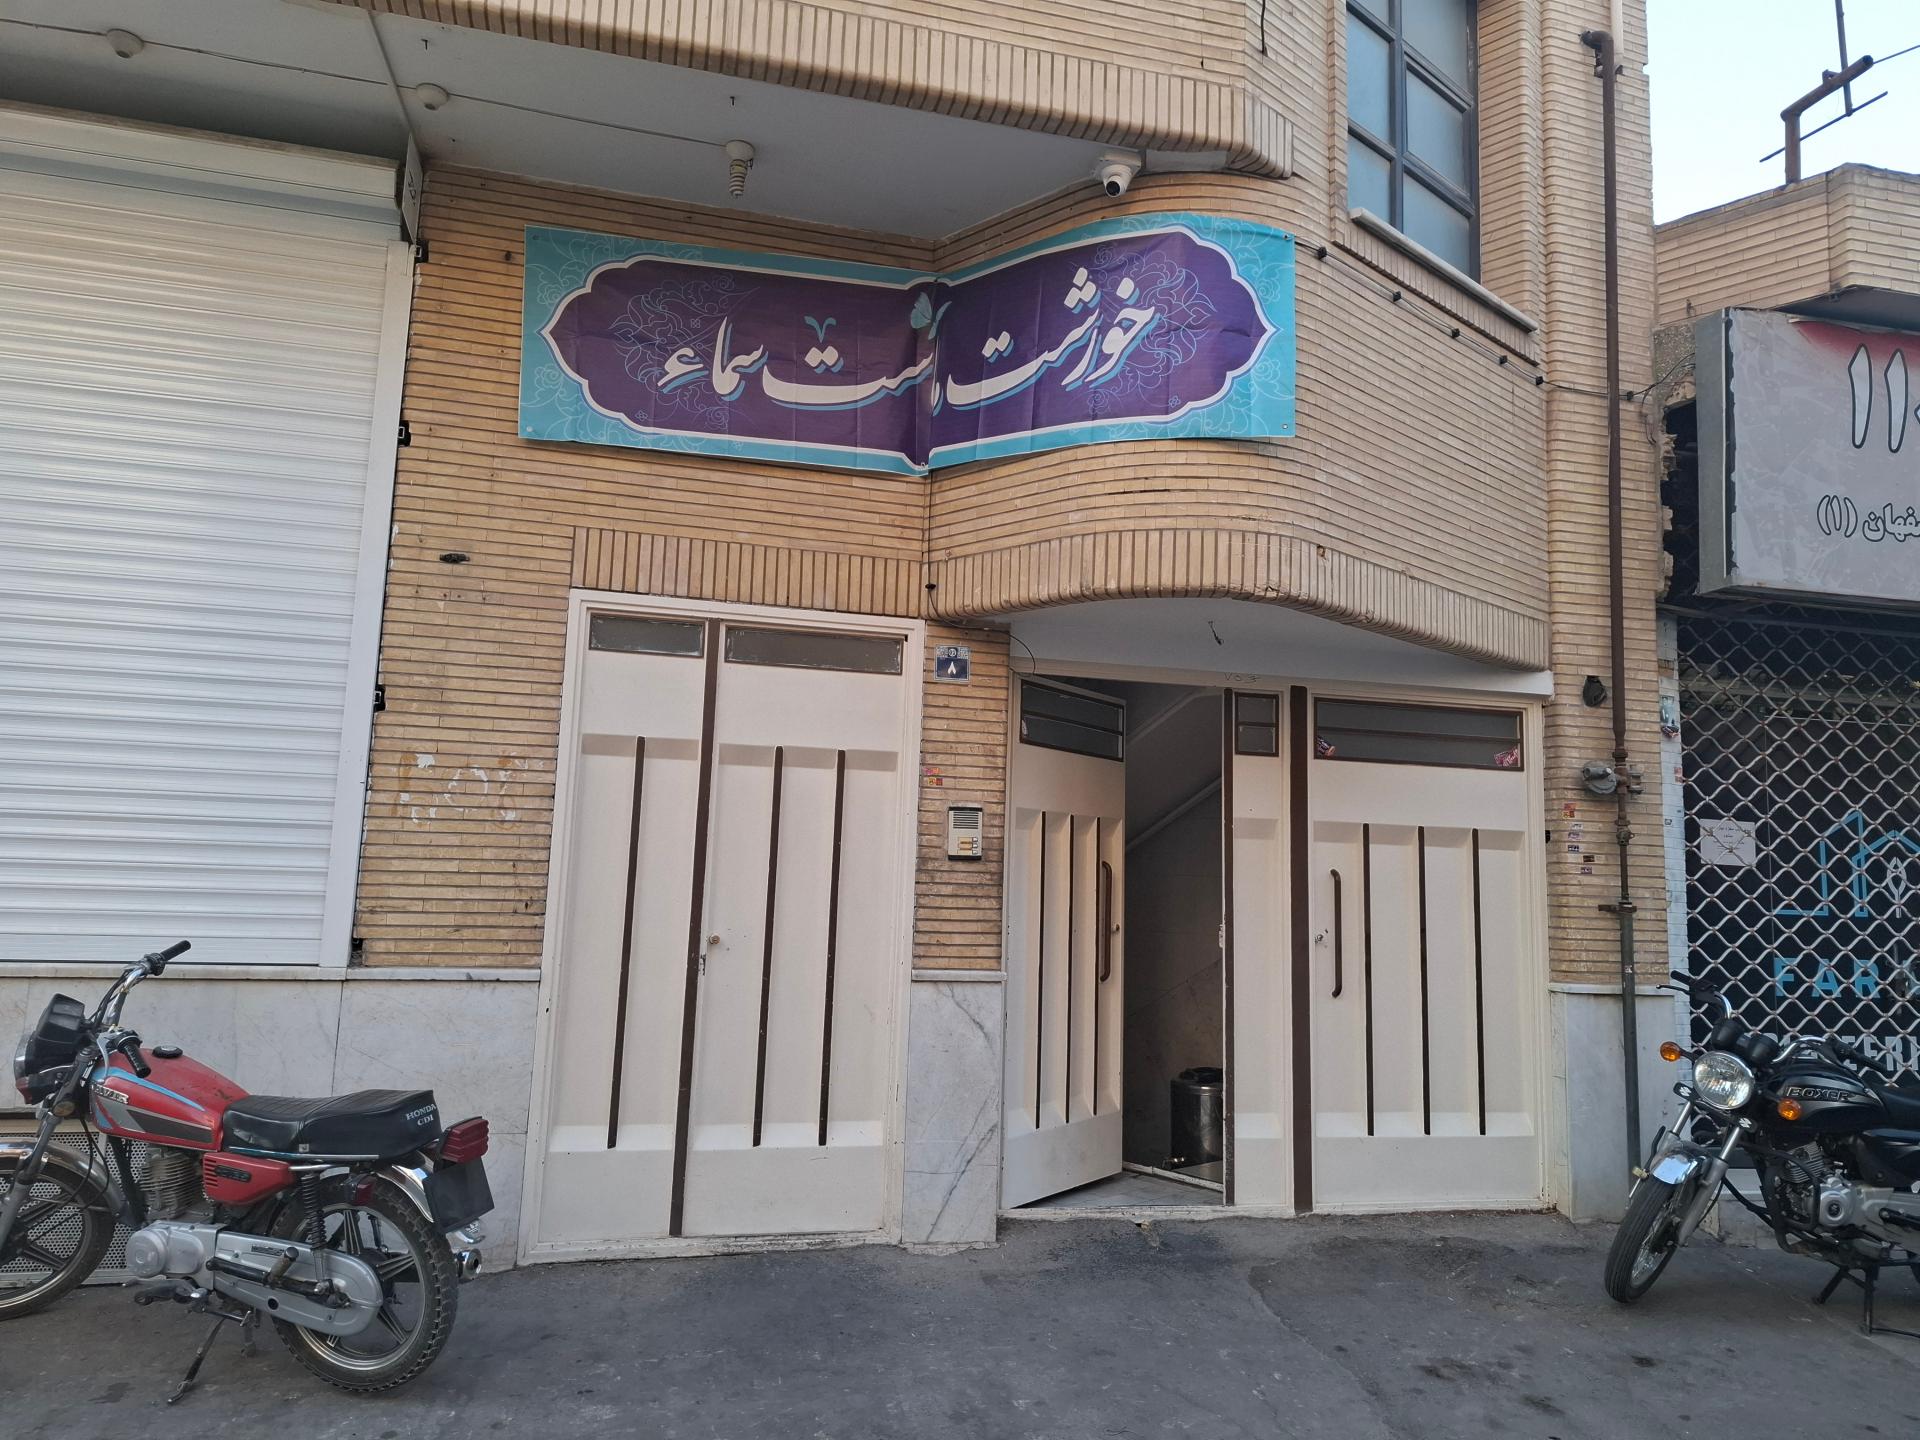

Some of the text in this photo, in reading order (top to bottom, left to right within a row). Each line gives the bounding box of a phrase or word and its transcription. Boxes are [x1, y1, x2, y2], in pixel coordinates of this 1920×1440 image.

[946, 267, 1157, 409] خورشت
[947, 661, 956, 674] ۸
[1786, 1086, 1852, 1102] BOXER
[406, 1103, 437, 1121] HONDA
[417, 1114, 434, 1126] CDI
